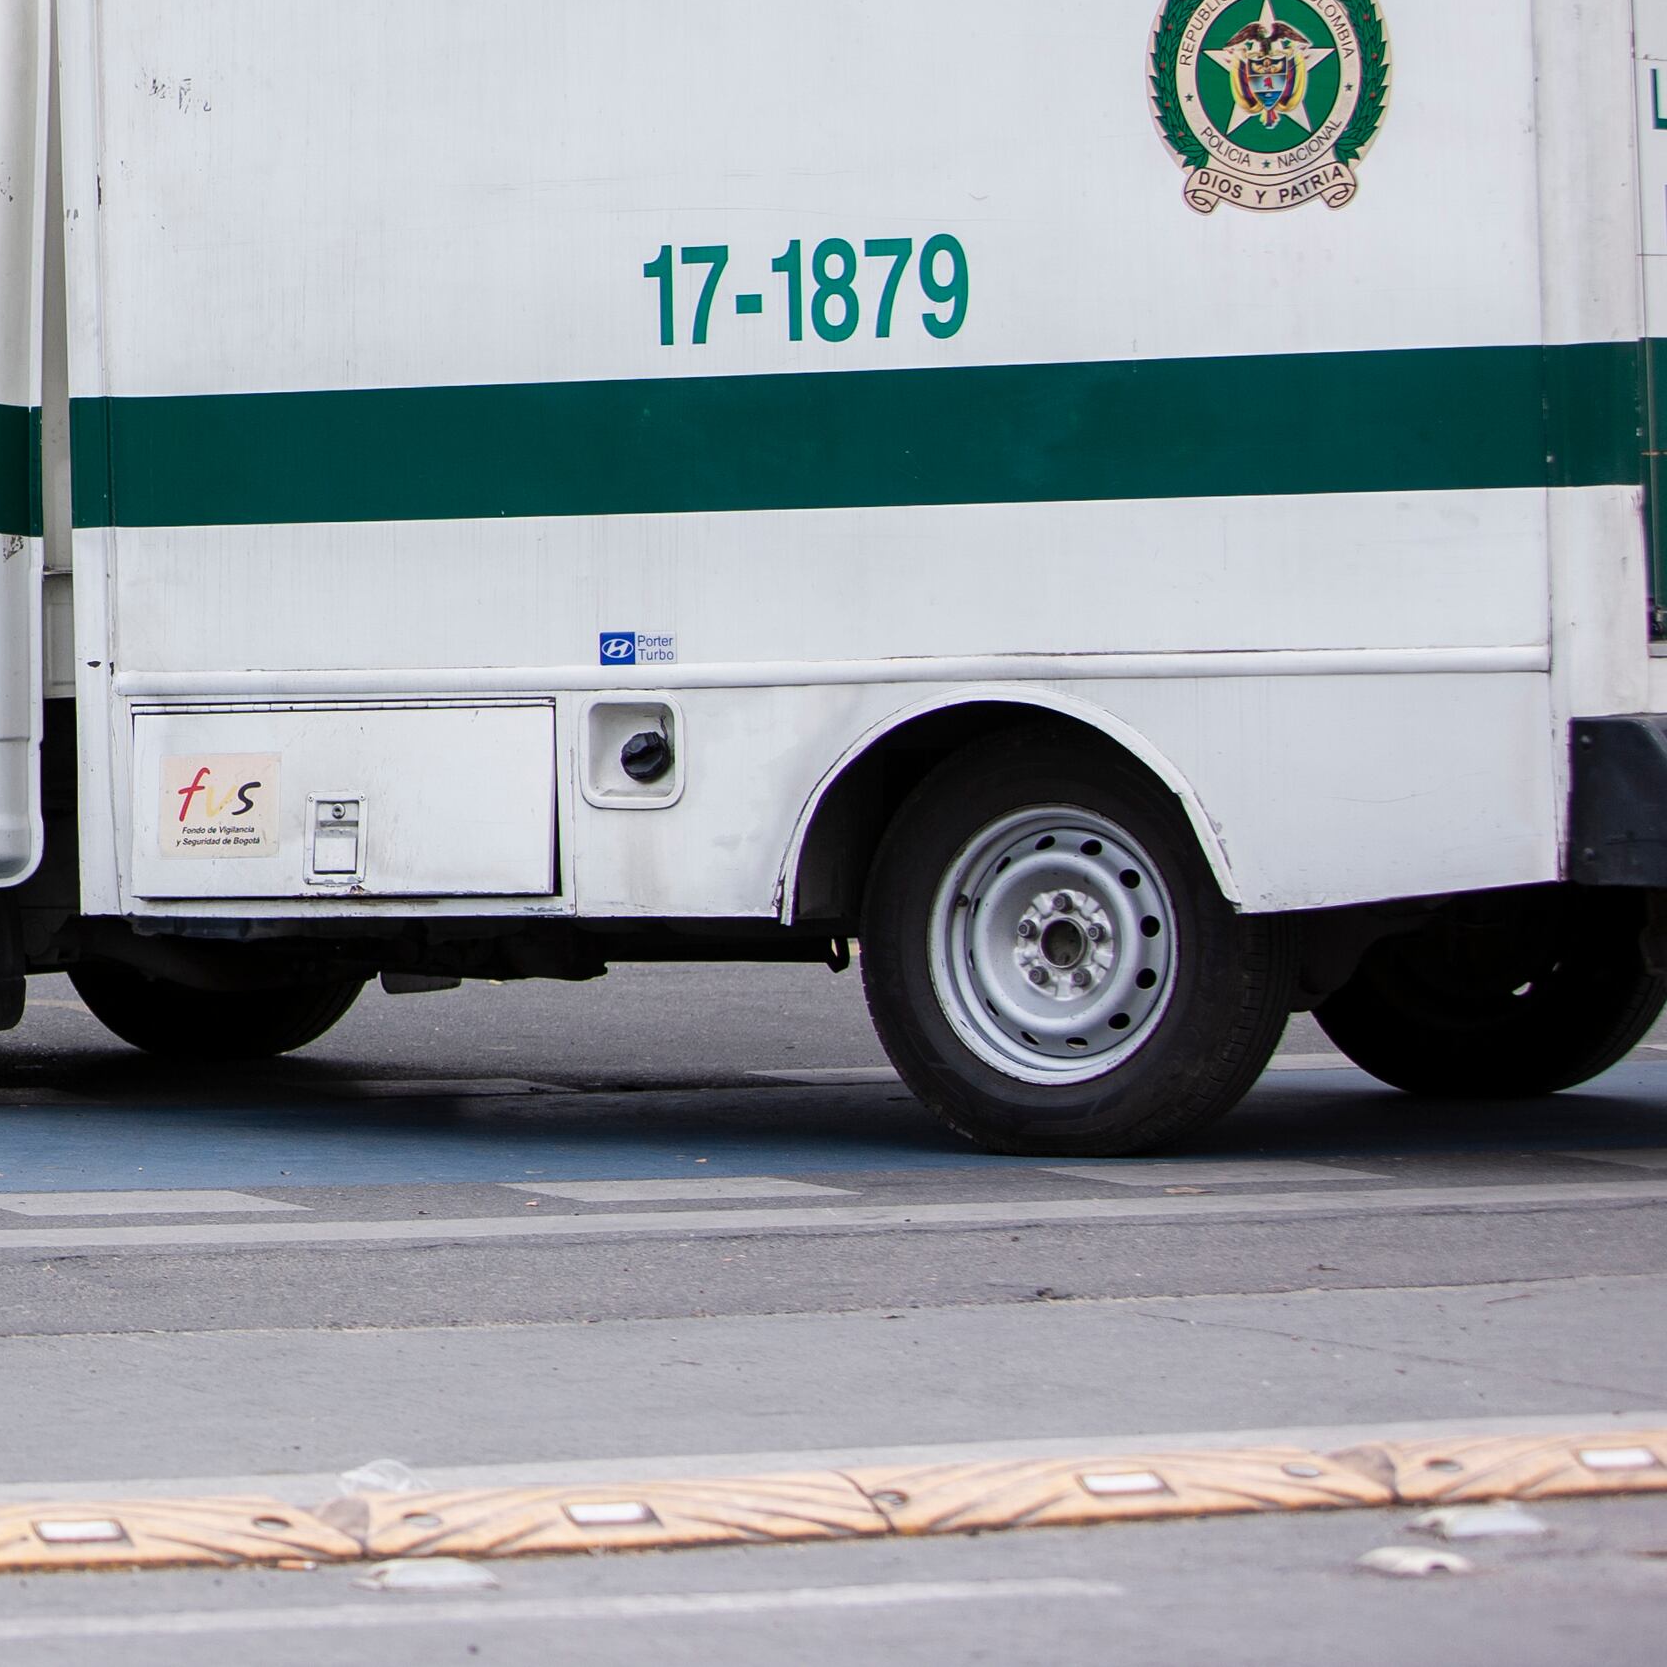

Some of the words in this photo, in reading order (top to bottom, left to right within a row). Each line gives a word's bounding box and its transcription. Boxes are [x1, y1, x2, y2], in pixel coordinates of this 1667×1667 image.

[1200, 126, 1252, 168] POLICIA
[1276, 118, 1343, 170] NACIONAL
[1198, 170, 1243, 200] DIOS
[1255, 189, 1267, 204] Y
[1278, 165, 1344, 204] PATRIA
[643, 232, 969, 346] 17-1879
[637, 635, 674, 647] Porter
[637, 649, 674, 661] Turbo
[178, 767, 262, 822] fvs
[182, 826, 206, 835] Fondo
[207, 826, 217, 834] de
[219, 825, 255, 836] Vigilancia
[182, 836, 221, 847] Seguridad
[223, 836, 232, 845] de
[233, 836, 260, 845] Bogotá
